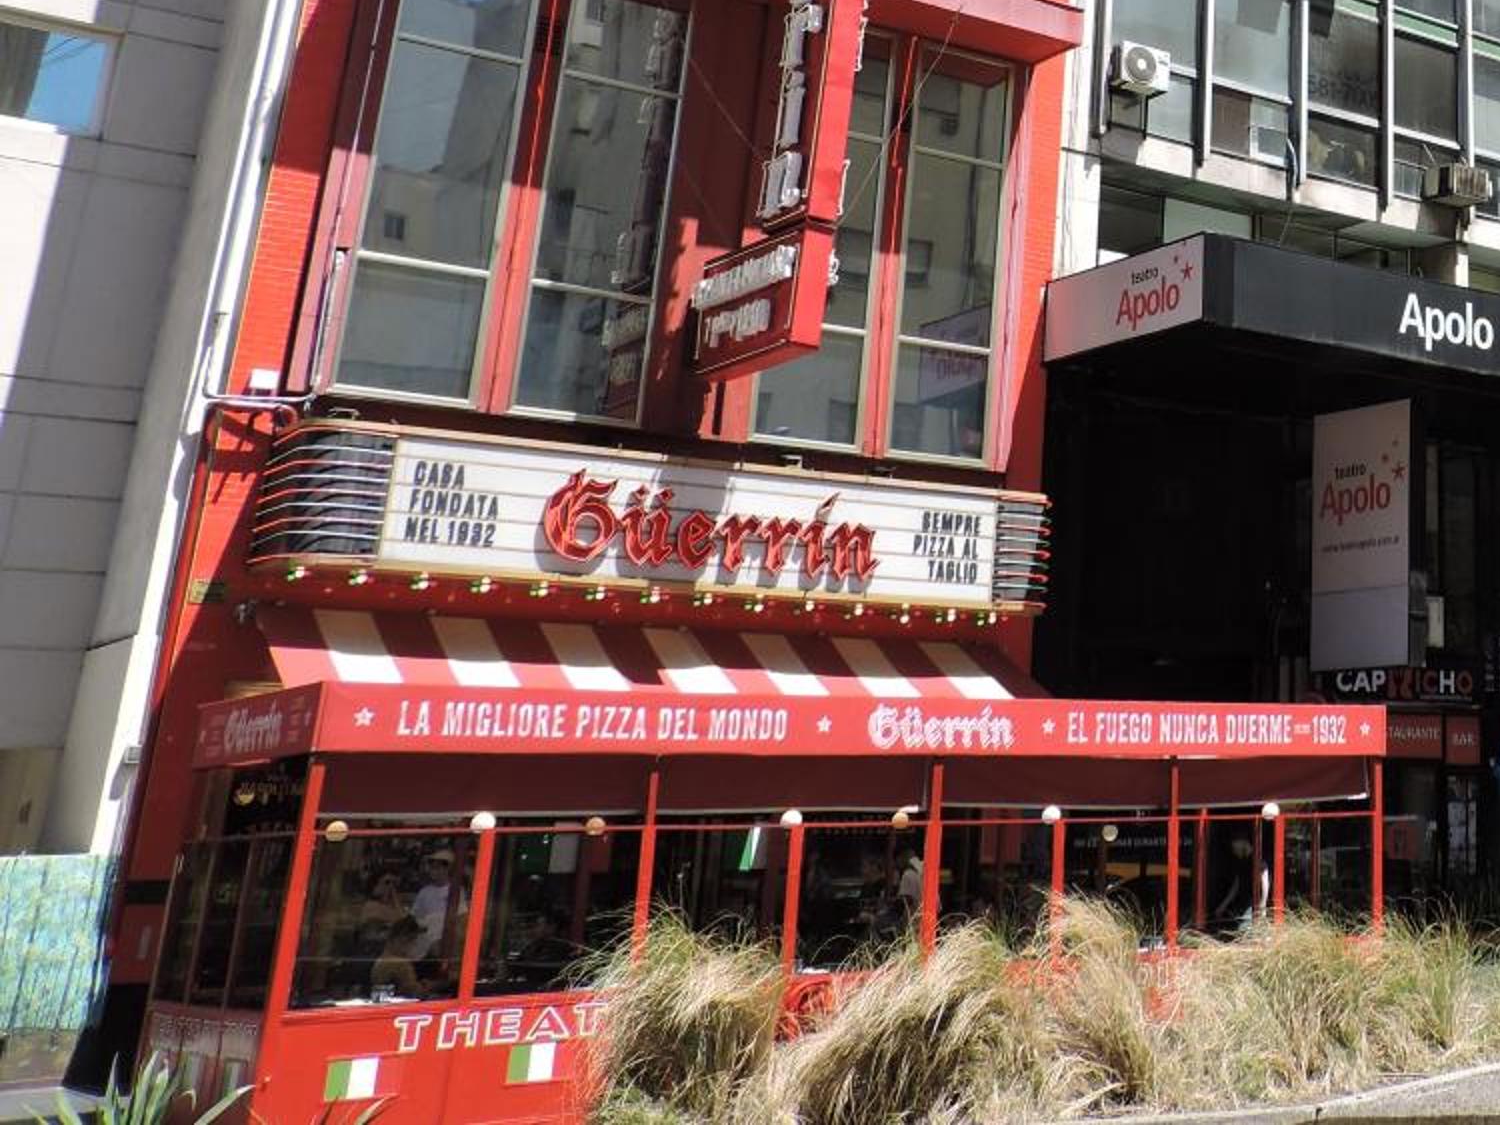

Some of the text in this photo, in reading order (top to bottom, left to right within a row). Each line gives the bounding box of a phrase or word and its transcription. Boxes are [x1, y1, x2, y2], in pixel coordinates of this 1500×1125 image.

[1131, 266, 1159, 286] teatro
[1116, 279, 1180, 330] Apolo
[1399, 292, 1494, 351] Apolo
[413, 460, 466, 490] CASA
[1335, 463, 1367, 479] teatro
[408, 488, 499, 520] FONDATA
[1320, 474, 1391, 524] Apolo
[404, 517, 497, 548] NEL 1932
[922, 510, 983, 537] SEMPRE
[912, 533, 979, 559] PIZZA AL
[927, 560, 979, 584] TAGLIO
[397, 700, 788, 741] LA MIGLIORE PIZZA DEL MONDO
[1067, 713, 1348, 746] EL FUEGO NUNCA DUERME 1932
